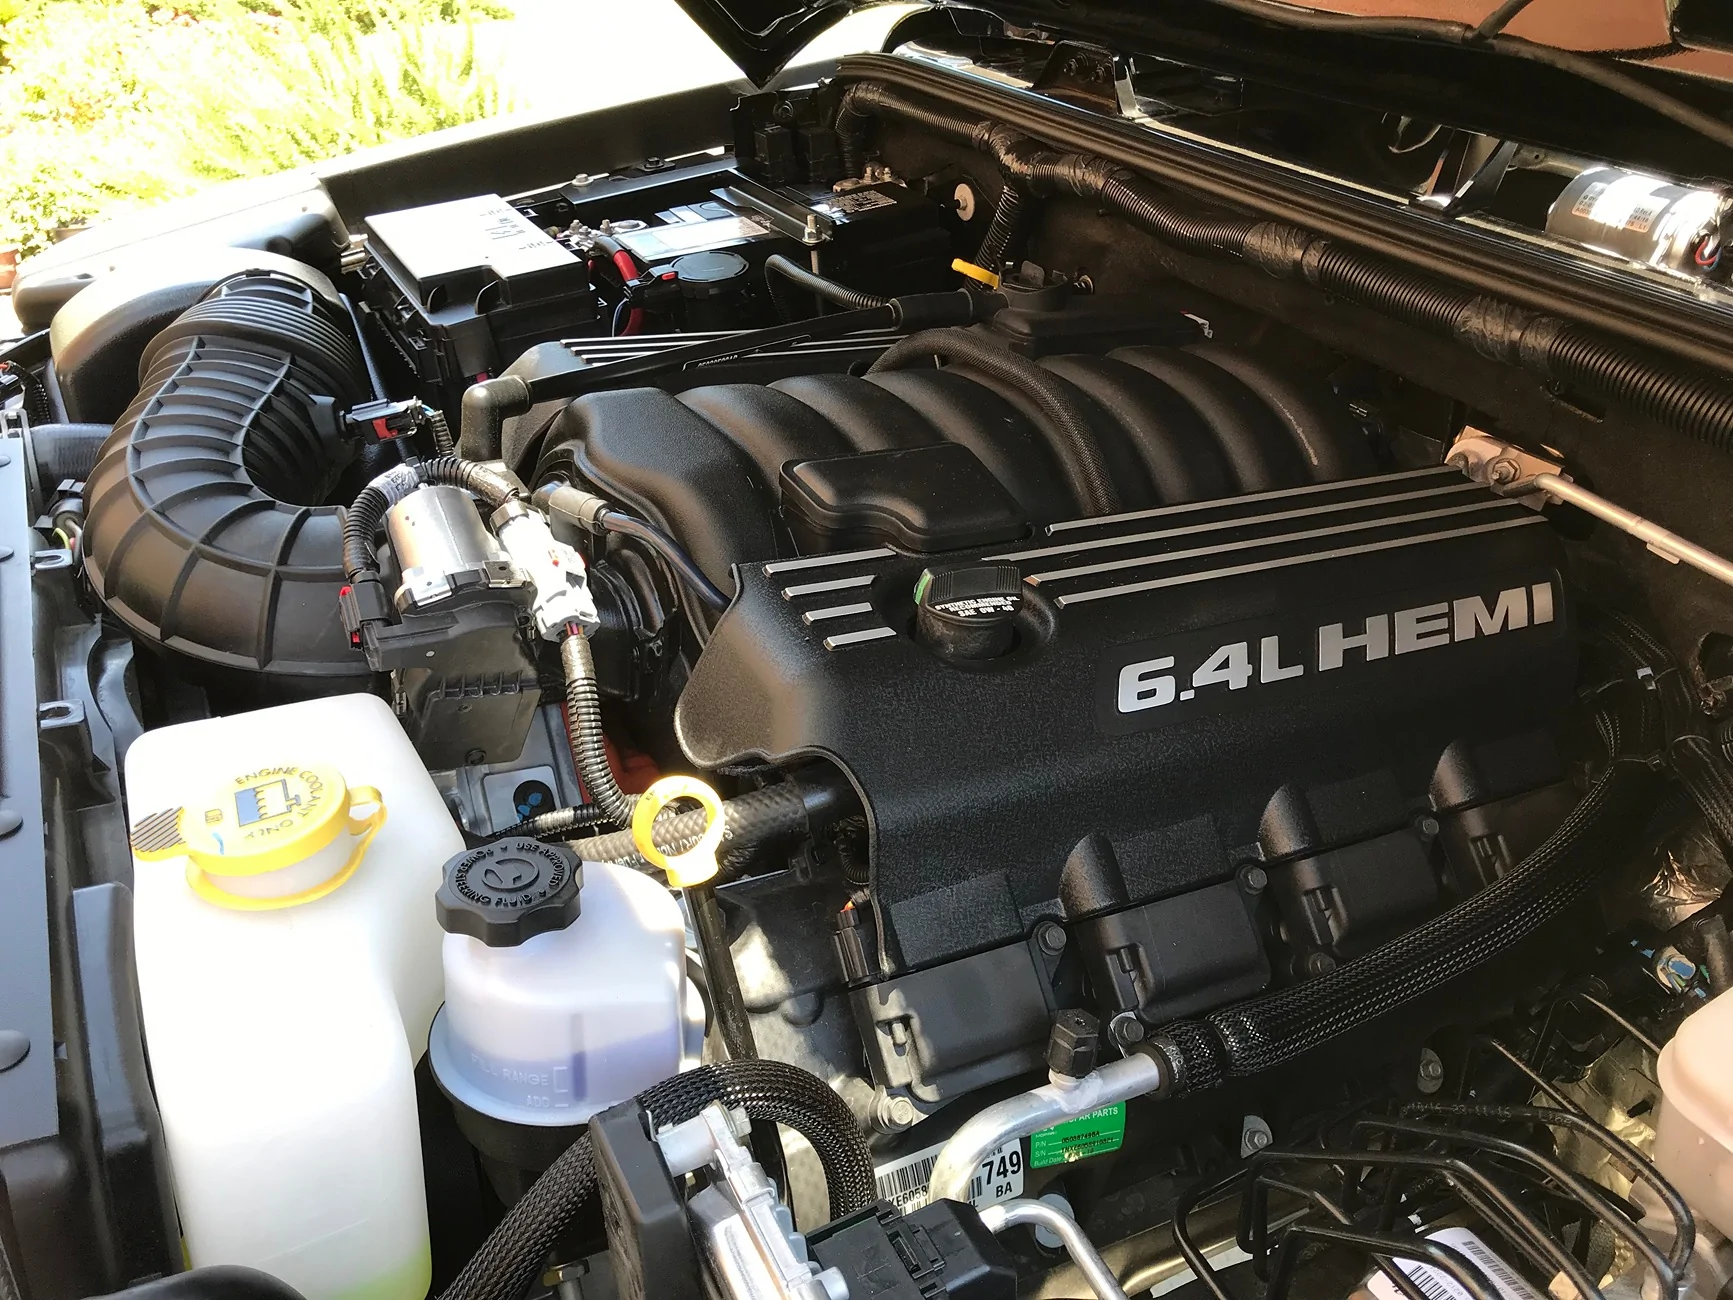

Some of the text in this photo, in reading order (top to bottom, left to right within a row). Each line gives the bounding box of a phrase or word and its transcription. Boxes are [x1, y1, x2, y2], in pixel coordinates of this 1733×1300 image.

[958, 609, 977, 617] SAE
[979, 606, 995, 614] 0W
[1117, 582, 1554, 713] 6.4L HEMI
[235, 766, 299, 785] ENGINE
[298, 770, 323, 818] COOLANT
[515, 842, 566, 887] USE APPROVED
[455, 848, 533, 908] POWER STEERING FLUID
[502, 1068, 549, 1086] RANGE
[526, 1095, 549, 1108] ADD
[1092, 1106, 1118, 1119] PARTS
[1035, 1150, 1046, 1158] S/N
[981, 1150, 1021, 1185] 749
[995, 1181, 1013, 1198] BA
